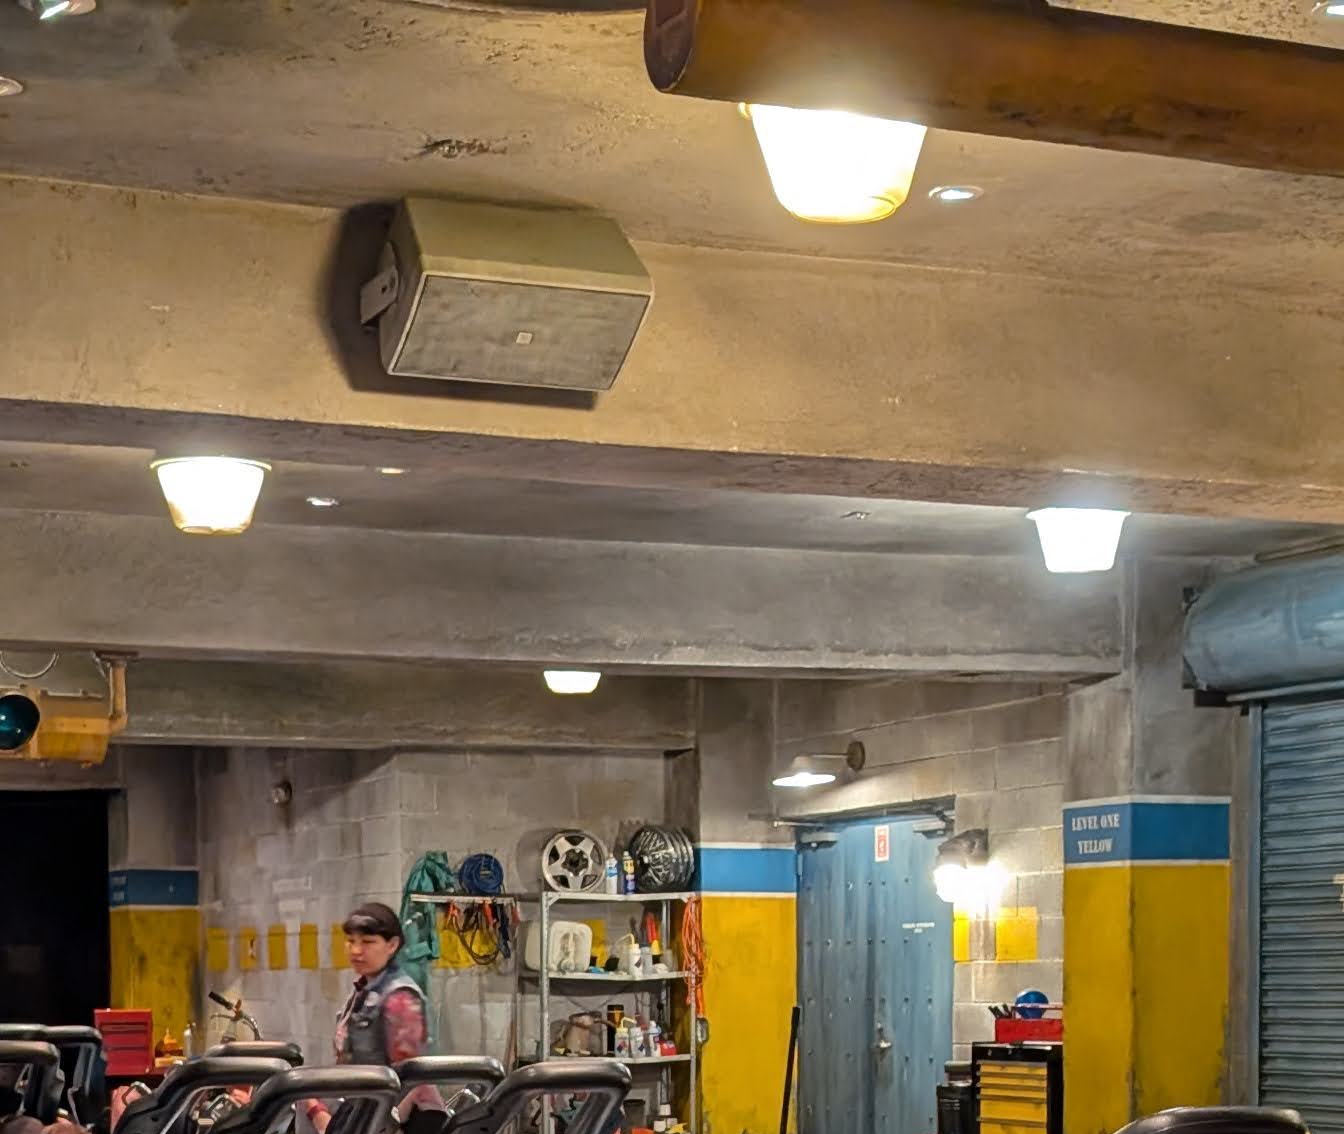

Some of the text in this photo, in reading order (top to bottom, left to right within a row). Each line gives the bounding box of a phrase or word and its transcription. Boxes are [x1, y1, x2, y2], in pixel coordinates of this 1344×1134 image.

[1071, 813, 1120, 831] LEVEL ONE
[1078, 839, 1113, 854] YELLOW
